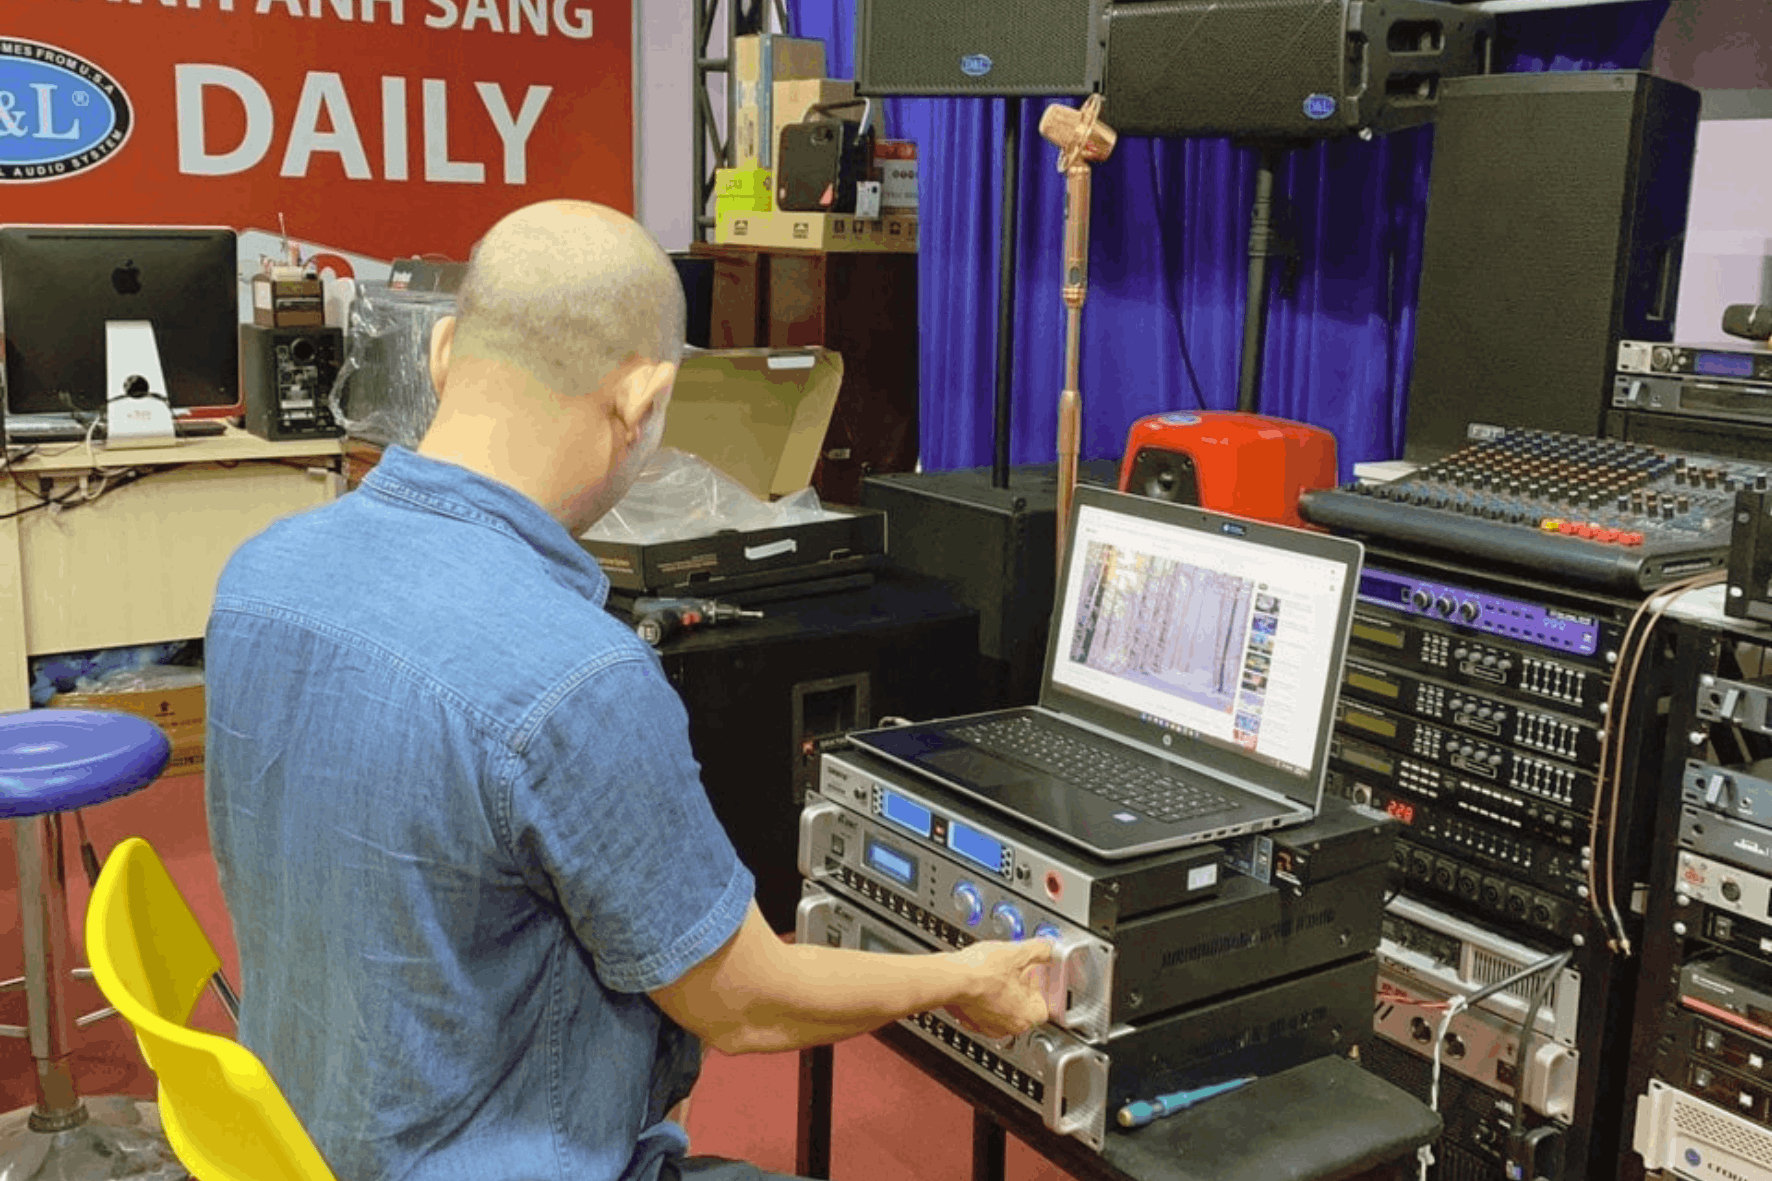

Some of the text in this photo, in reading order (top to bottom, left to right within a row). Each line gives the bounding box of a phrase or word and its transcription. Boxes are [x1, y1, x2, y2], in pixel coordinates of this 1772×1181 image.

[36, 48, 78, 69] FROM
[174, 63, 554, 185] DAILY
[13, 129, 123, 177] AUDIO SYSTEM
